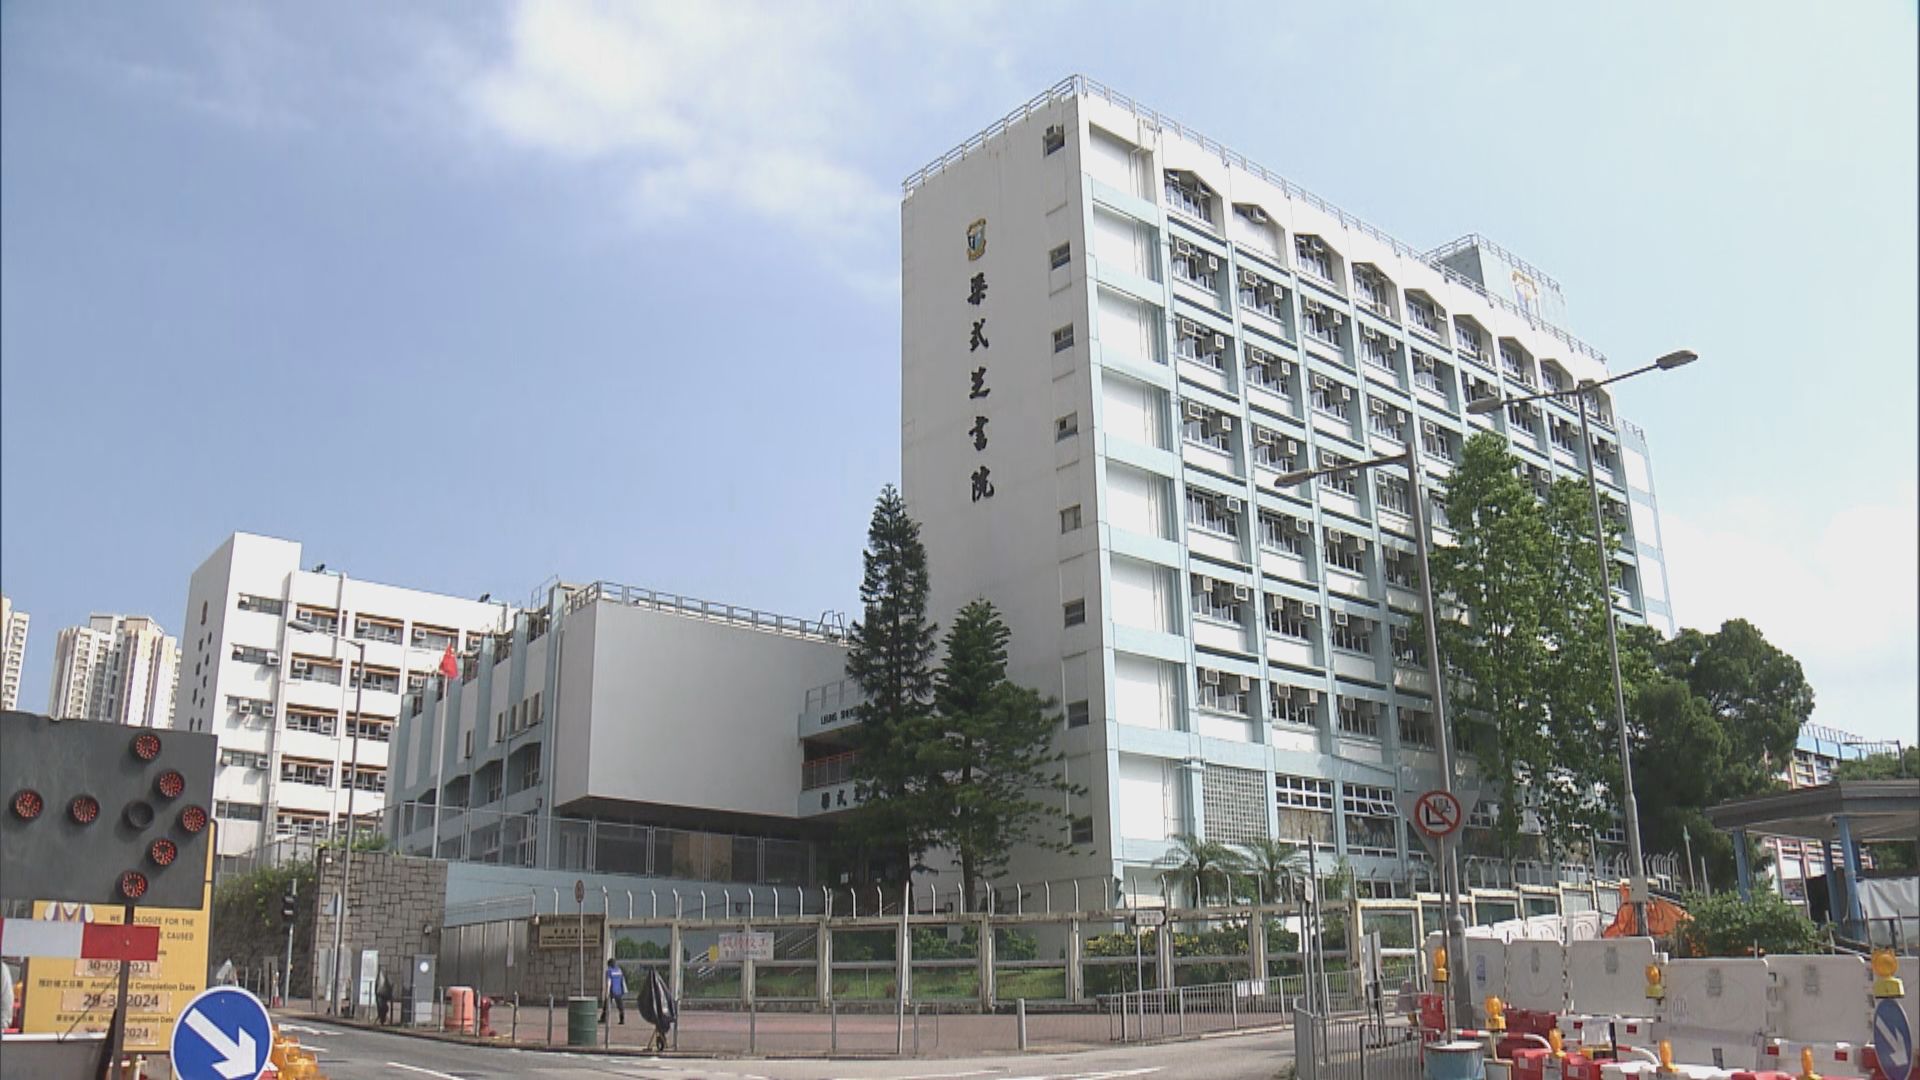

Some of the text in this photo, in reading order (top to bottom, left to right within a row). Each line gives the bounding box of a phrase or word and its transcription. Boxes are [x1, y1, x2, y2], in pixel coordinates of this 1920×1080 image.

[967, 272, 995, 503] 梁式芝書院
[109, 914, 121, 923] WE
[165, 917, 179, 926] FOR
[182, 917, 194, 927] THE
[167, 931, 194, 941] CAUSED
[135, 982, 178, 992] Completion
[179, 983, 196, 992] Date
